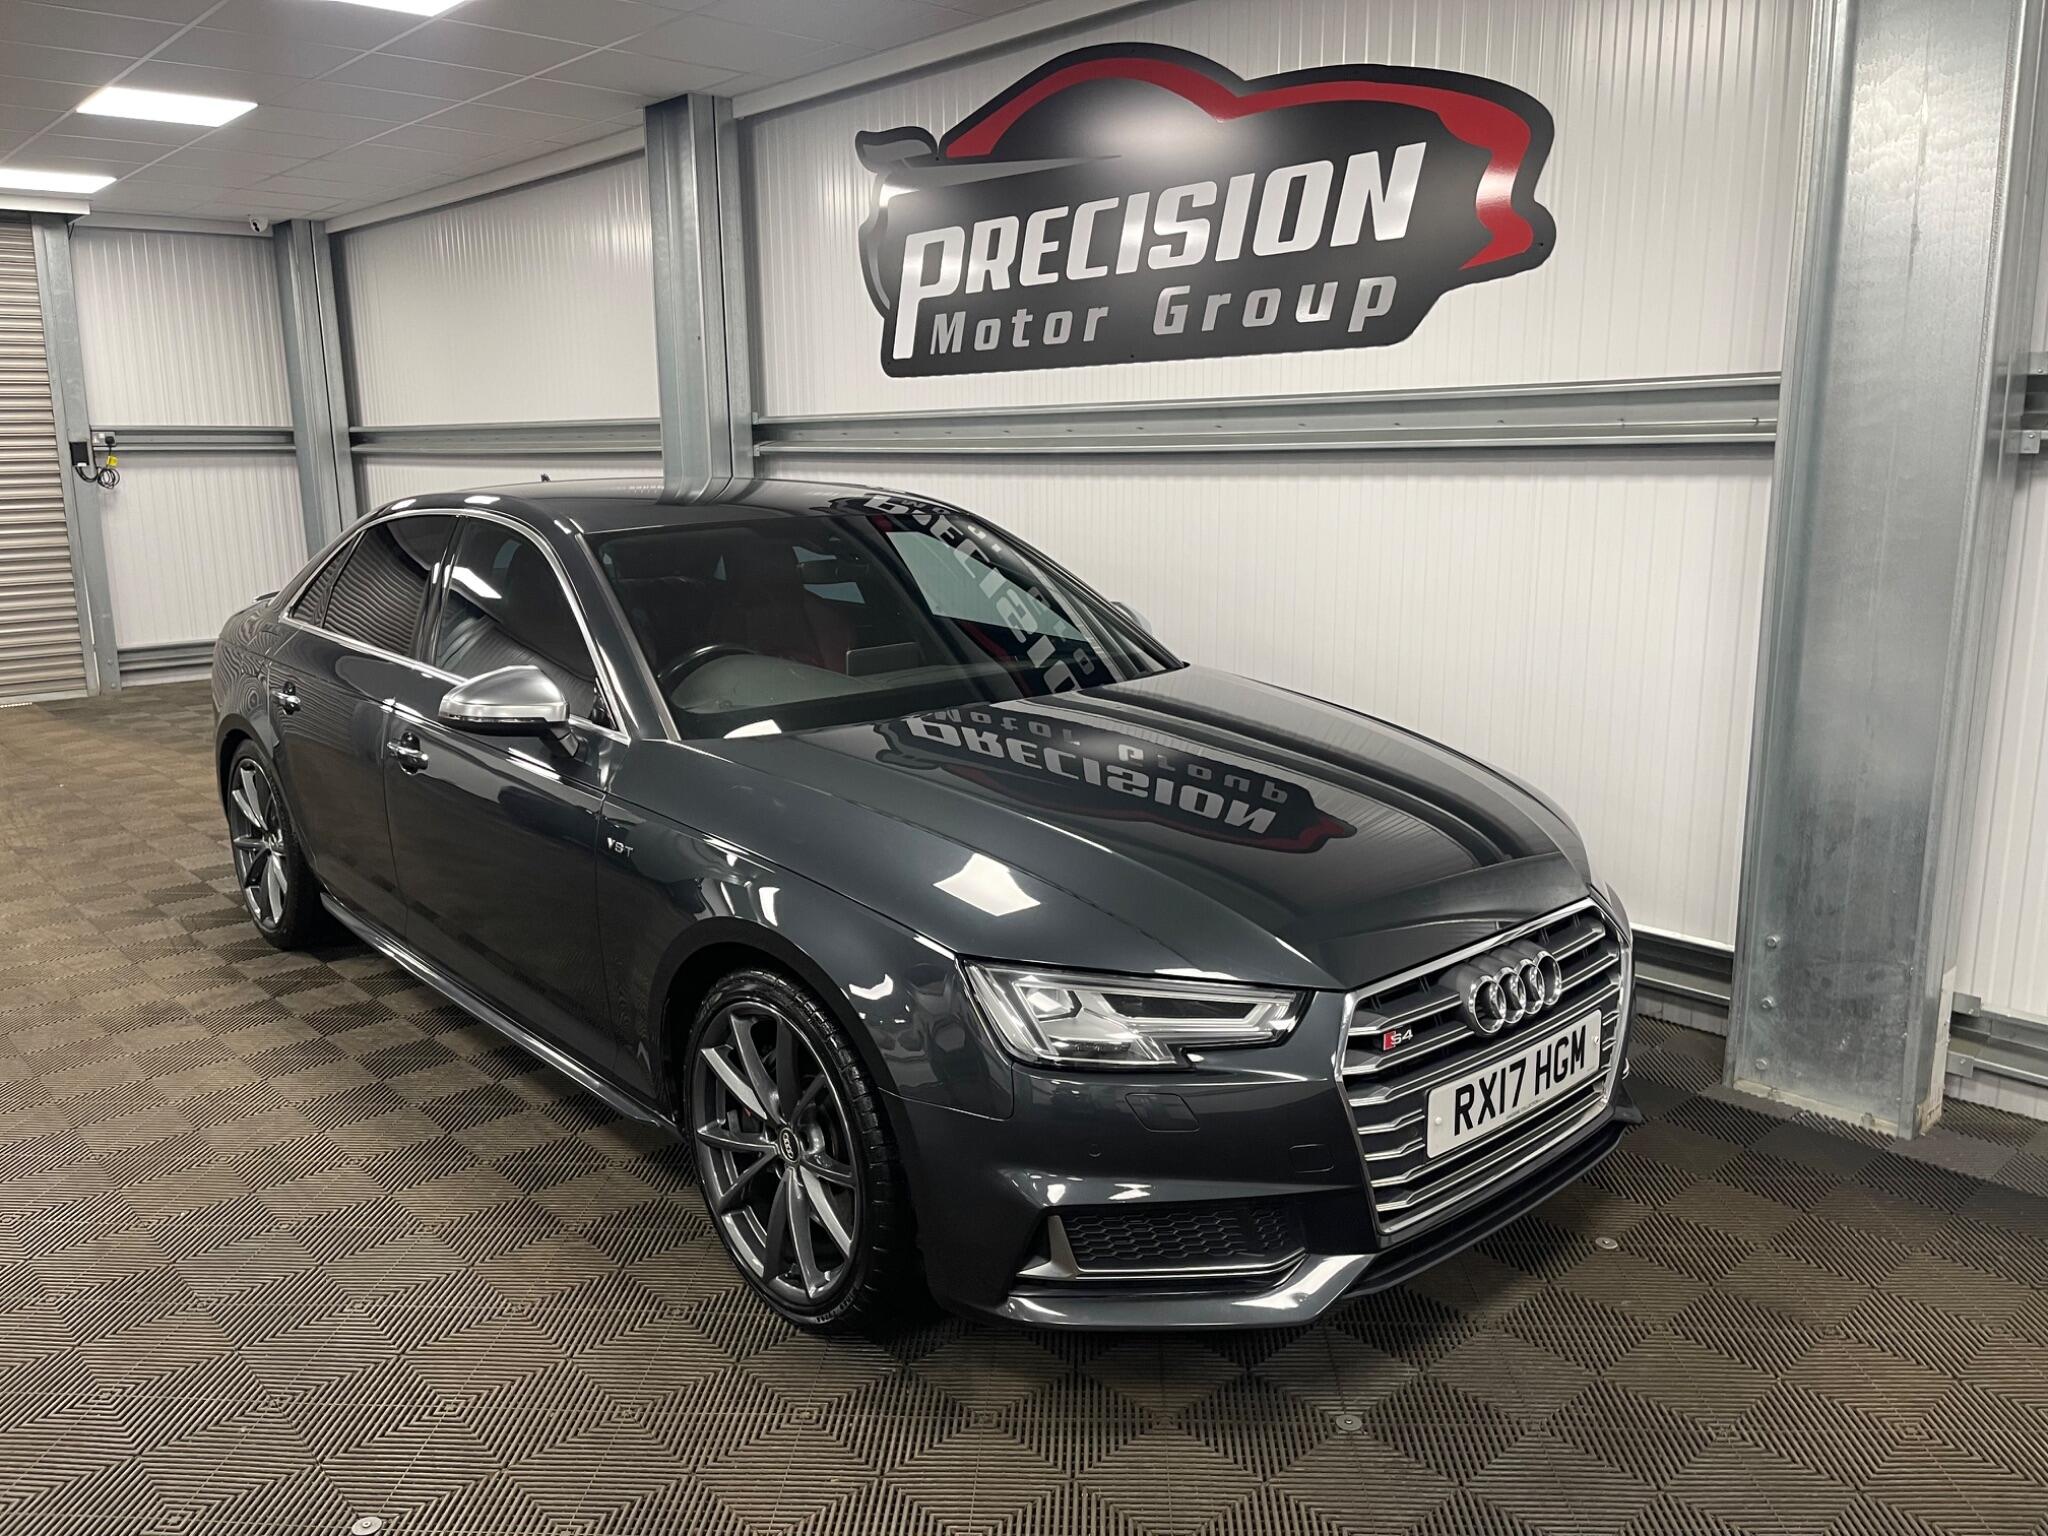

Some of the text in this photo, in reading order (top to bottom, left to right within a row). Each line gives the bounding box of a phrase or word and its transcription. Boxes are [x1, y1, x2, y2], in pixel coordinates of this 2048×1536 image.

[892, 141, 1427, 359] PRECISION
[930, 275, 1397, 355] Motor Group
[1390, 1028, 1414, 1046] S4
[1454, 1024, 1587, 1137] RX17 HGM
